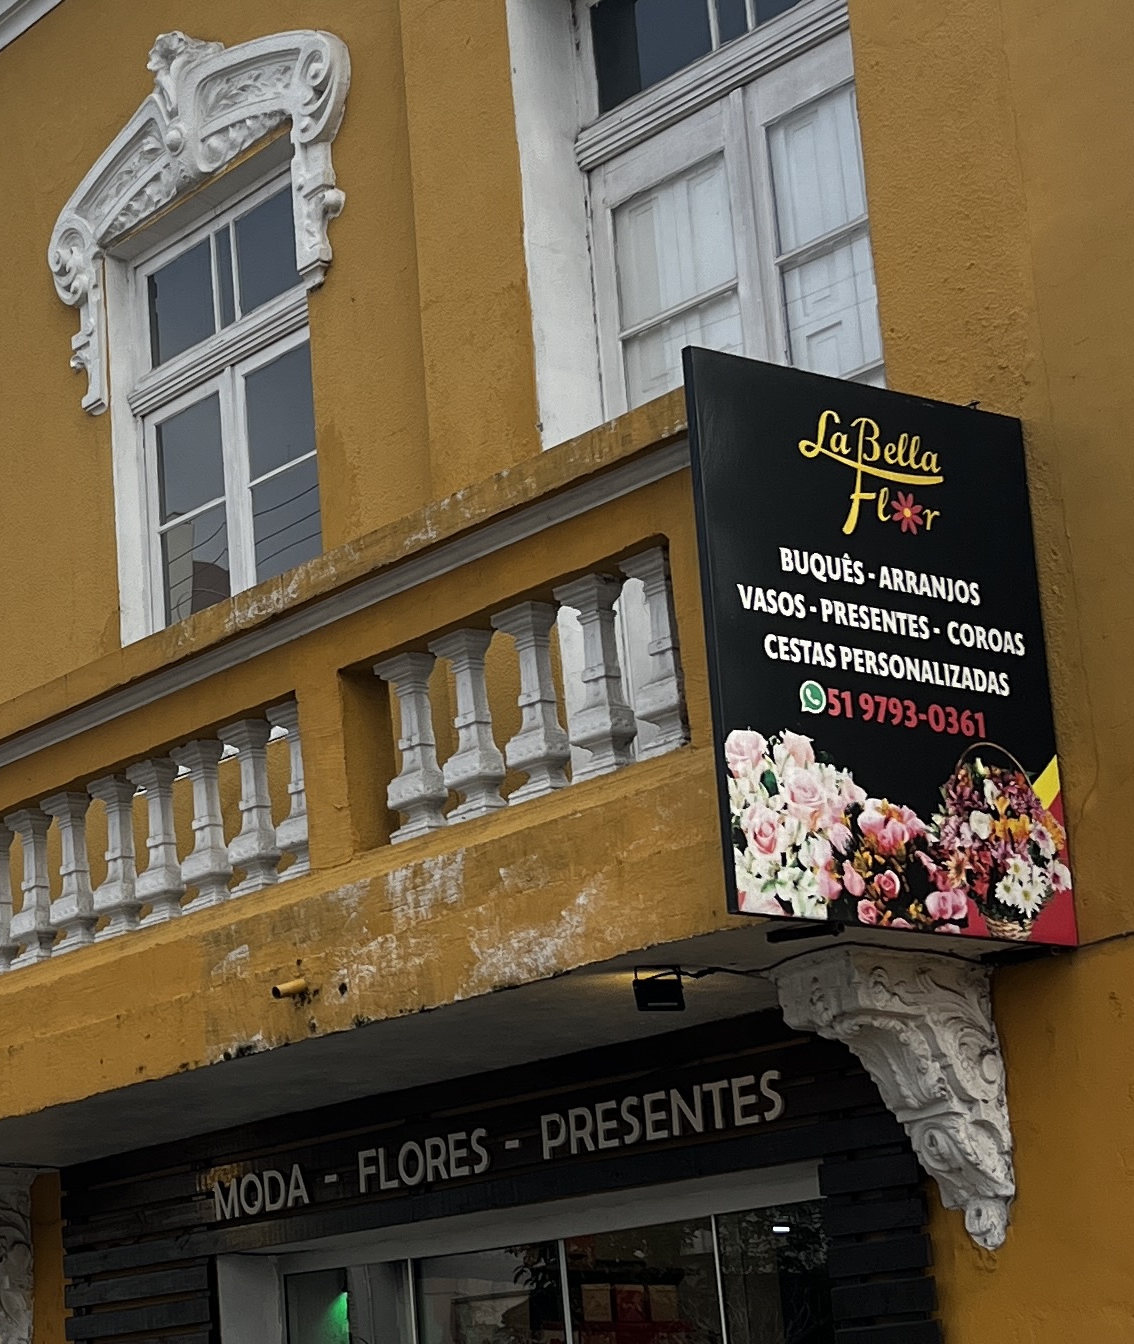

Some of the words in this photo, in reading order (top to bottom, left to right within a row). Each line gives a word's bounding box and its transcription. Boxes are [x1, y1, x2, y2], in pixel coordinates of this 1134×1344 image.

[798, 410, 852, 459] La
[850, 417, 941, 474] Bella
[778, 546, 865, 585] BUQUÊS
[878, 565, 981, 606] ARRANJOS
[736, 583, 806, 619] VASOS
[819, 598, 930, 640] PRESENTES
[947, 621, 1026, 657] COROAS
[764, 633, 837, 669] CESTAS
[839, 645, 1010, 697] PERSONALIZADAS
[826, 687, 853, 719] 51
[858, 692, 986, 739] 9793-0361
[213, 1162, 312, 1222] MODA
[358, 1127, 491, 1194] FLORES
[540, 1069, 786, 1160] PRESENTES
